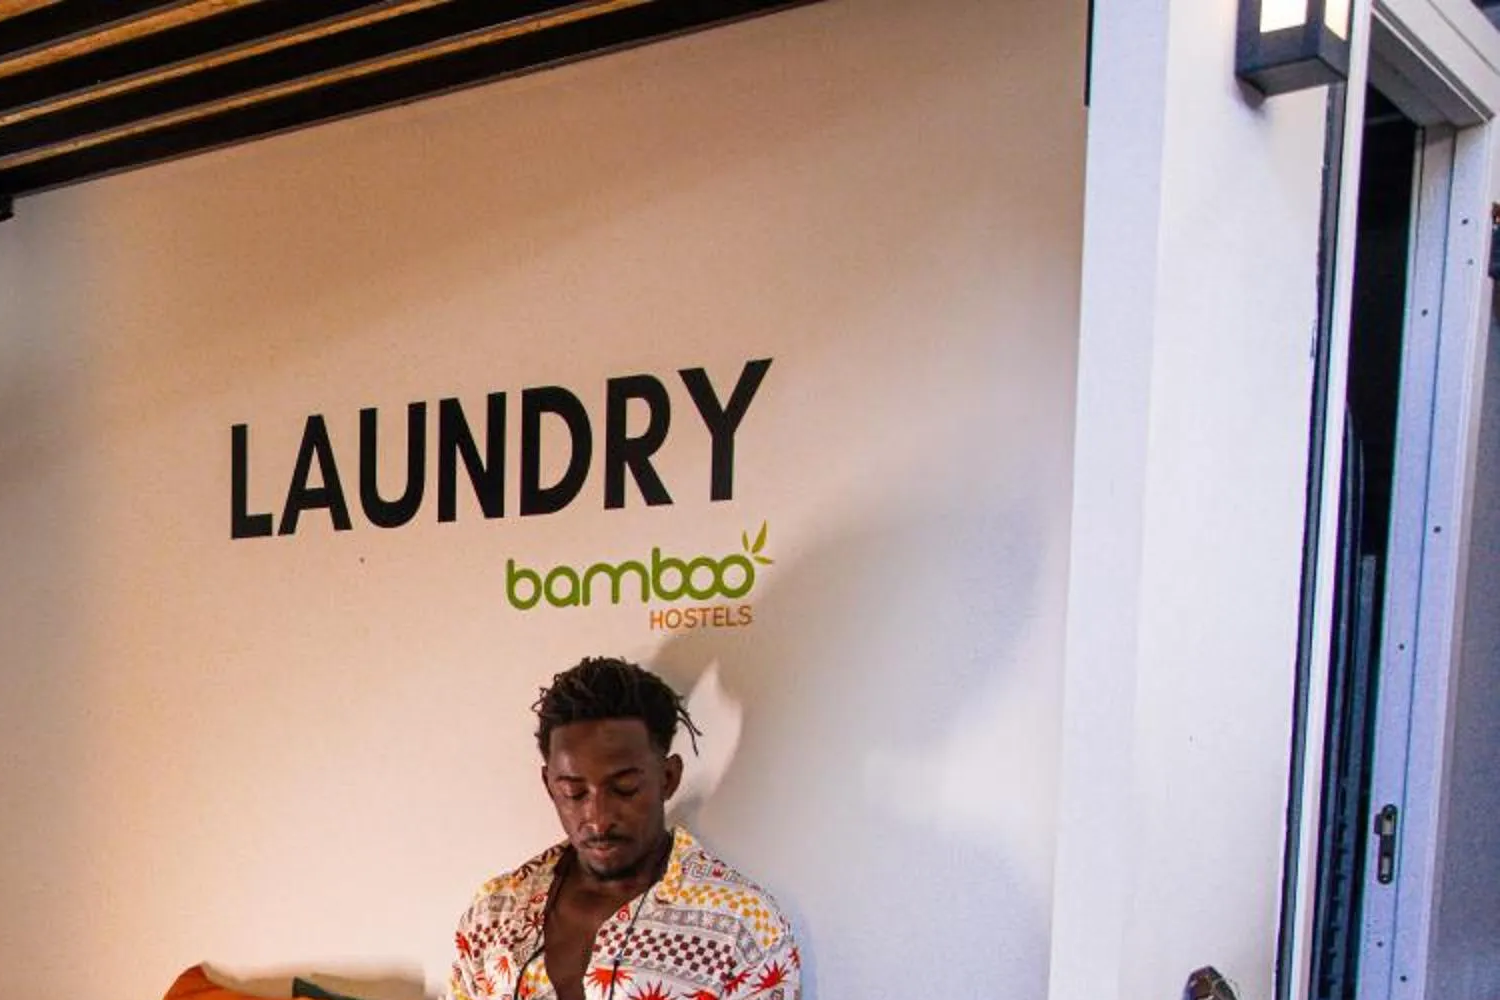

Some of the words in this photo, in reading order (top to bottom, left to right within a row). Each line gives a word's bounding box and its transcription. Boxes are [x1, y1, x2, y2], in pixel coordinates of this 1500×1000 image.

[231, 358, 773, 539] LAUNDRY
[506, 547, 755, 610] bamboo
[650, 605, 752, 629] HOSTELS
